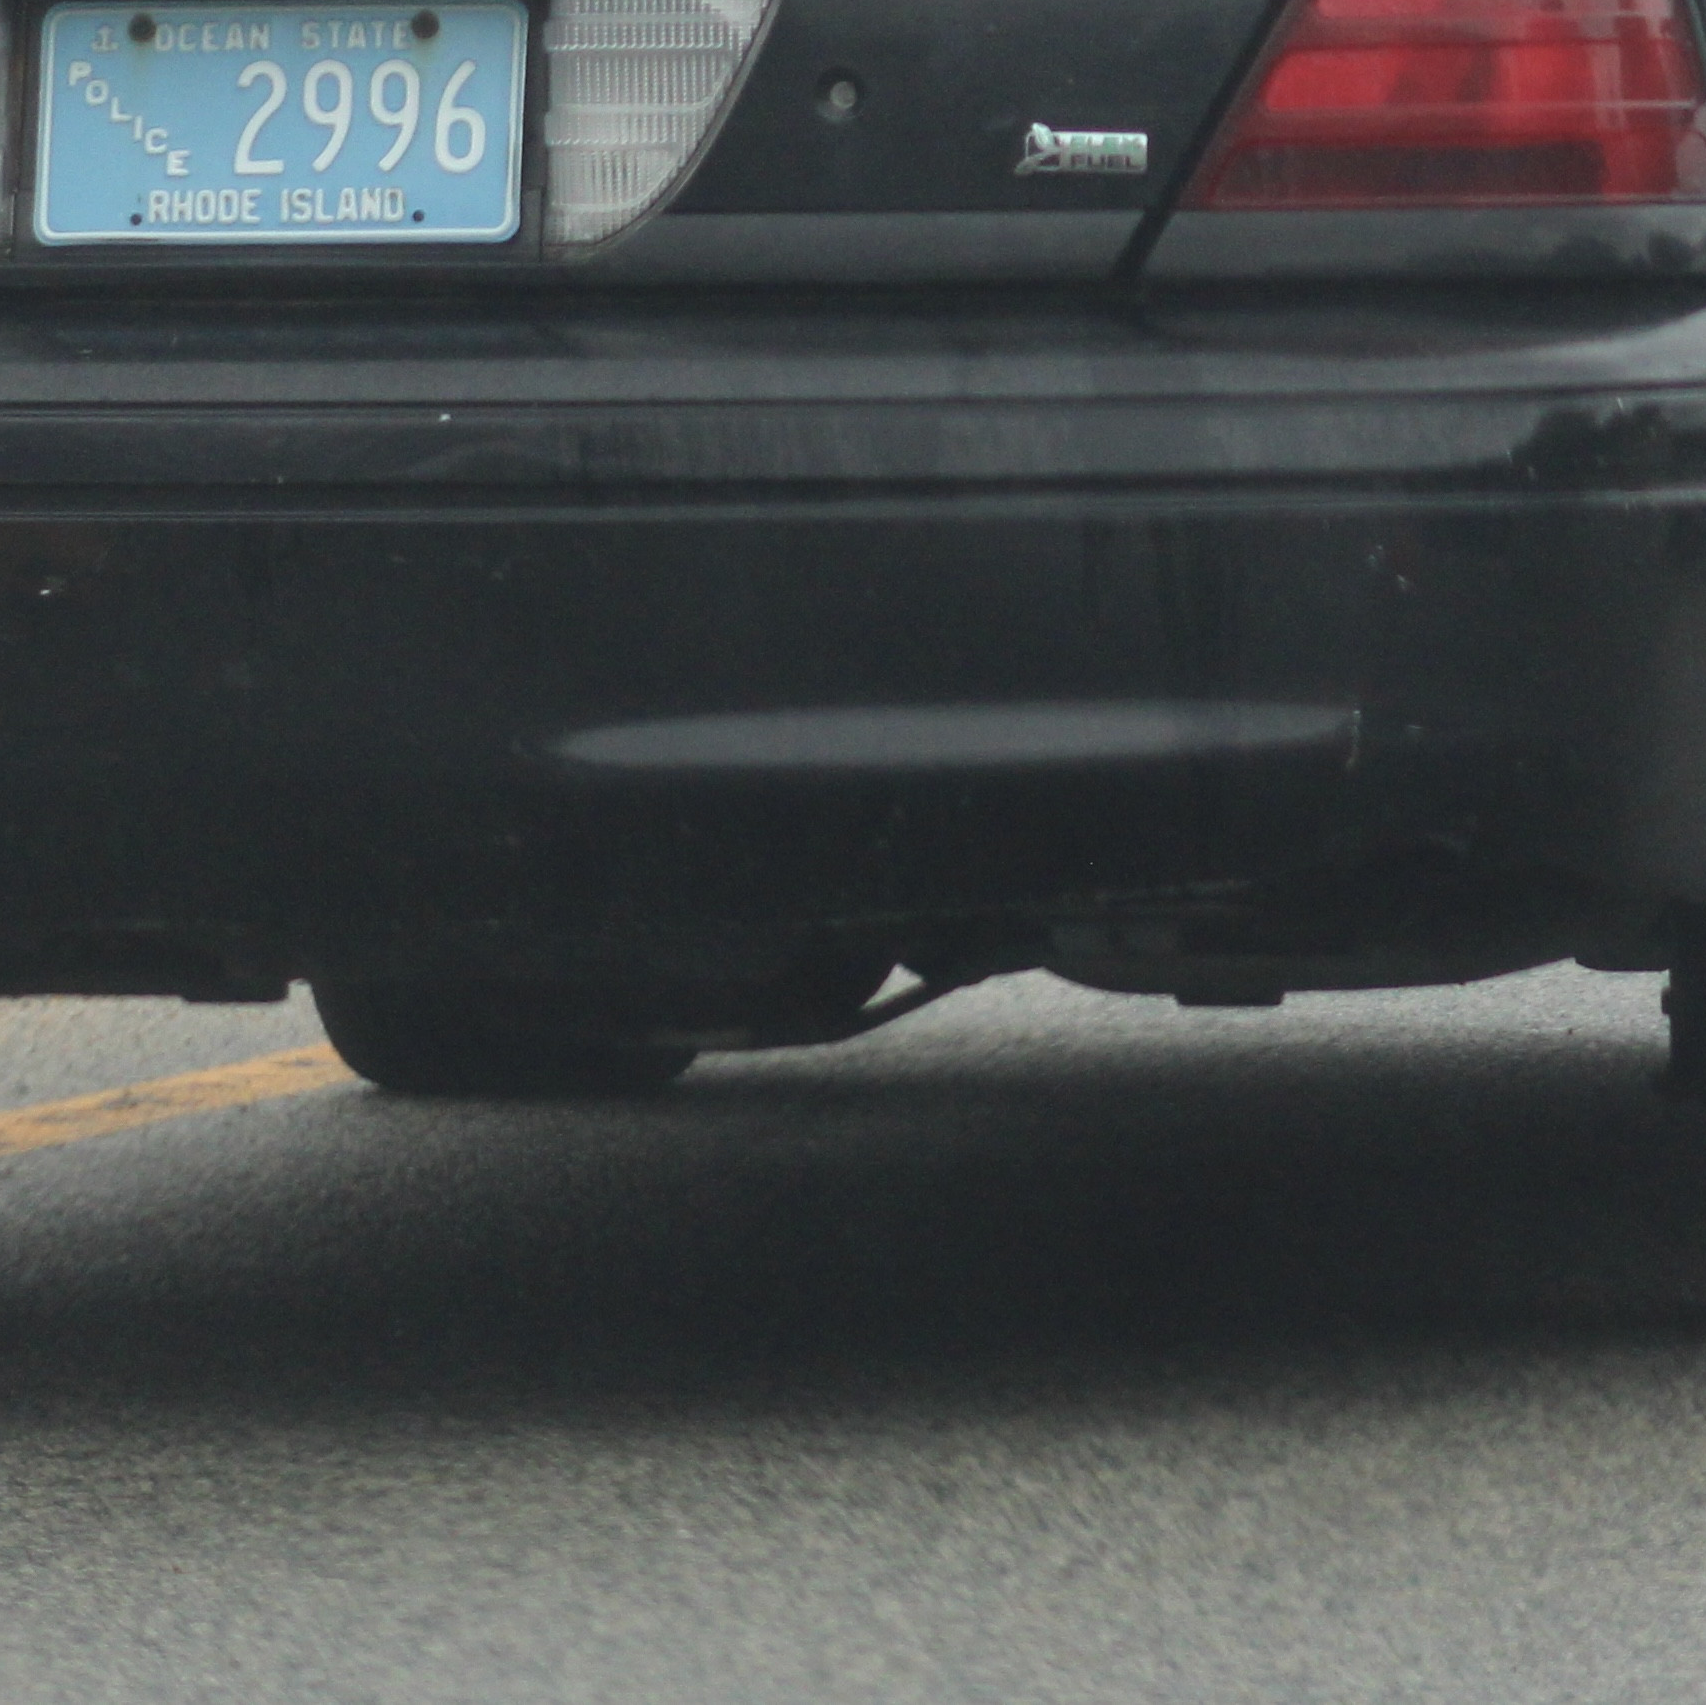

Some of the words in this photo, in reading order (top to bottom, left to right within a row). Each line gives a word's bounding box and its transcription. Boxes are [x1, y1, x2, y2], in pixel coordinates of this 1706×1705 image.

[154, 21, 271, 53] OCEAN
[301, 19, 412, 52] STATE
[67, 59, 191, 178] POLICE
[233, 58, 488, 175] 2996
[147, 188, 262, 225] RHODE
[279, 186, 406, 224] ISLAND
